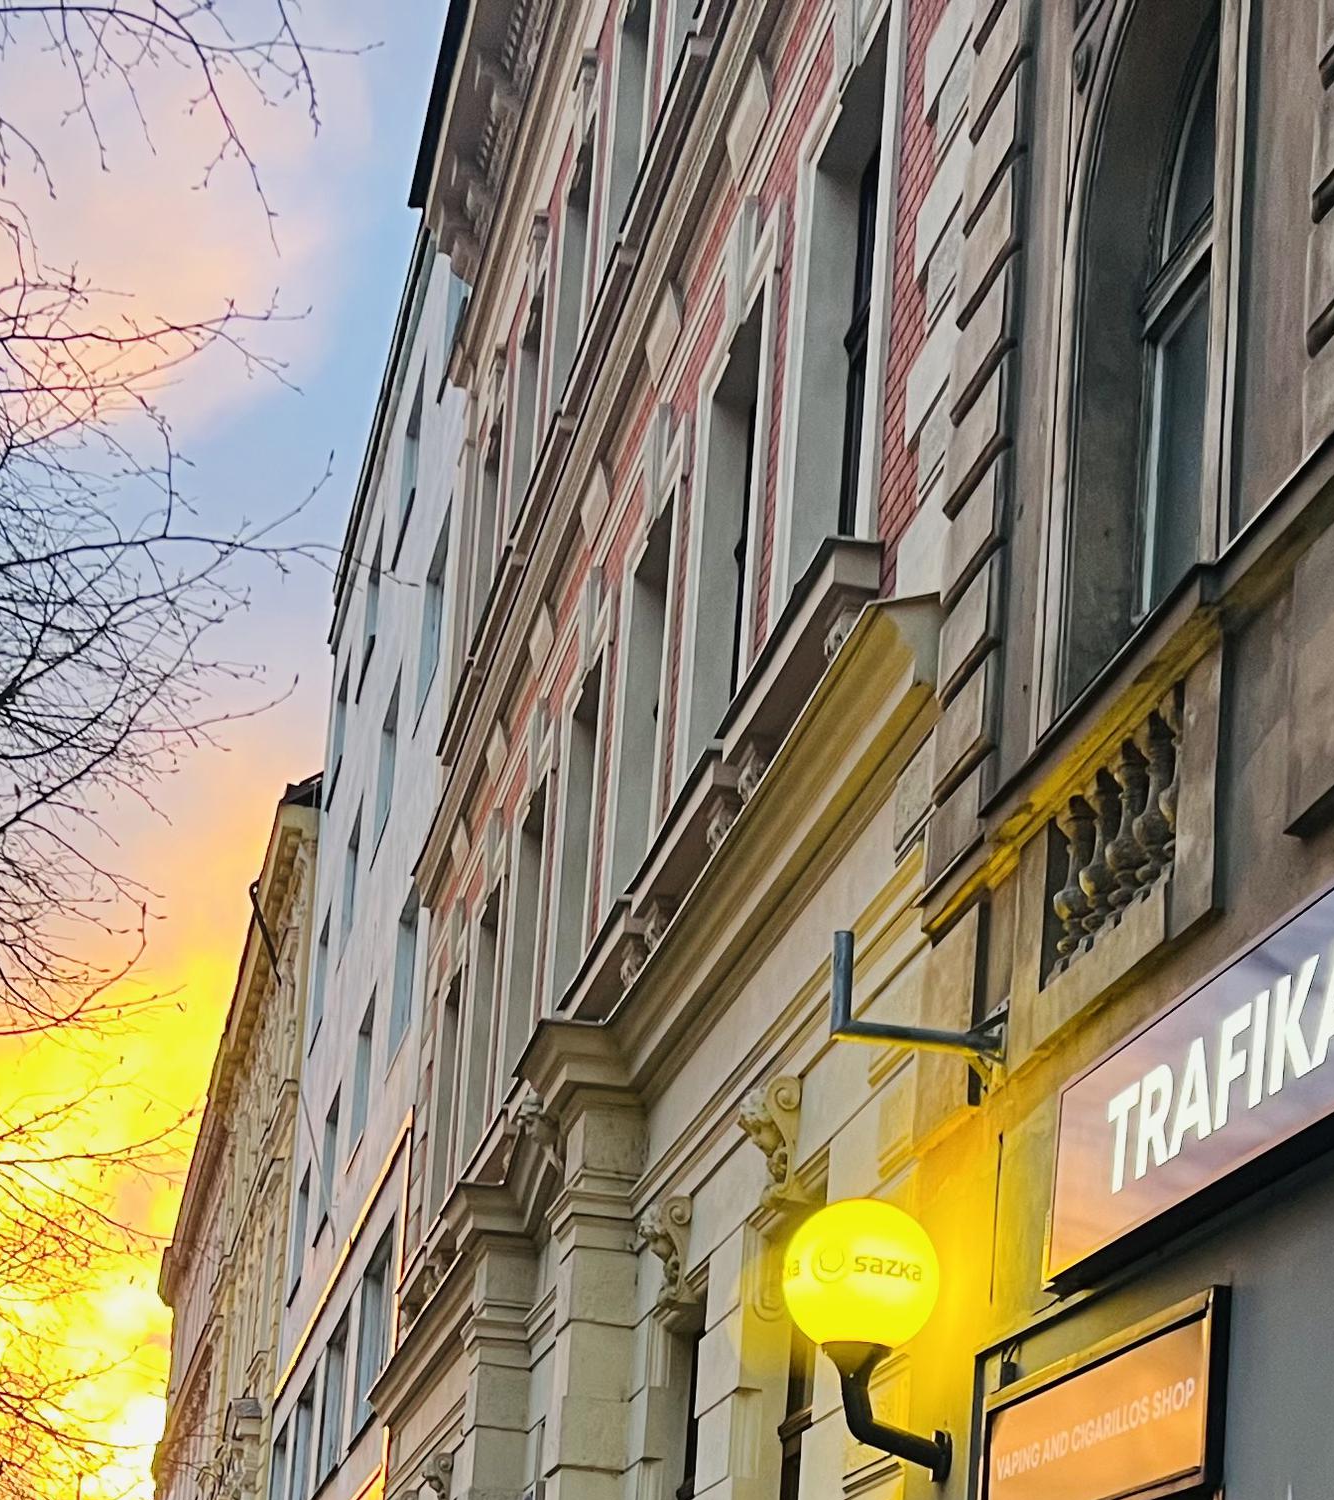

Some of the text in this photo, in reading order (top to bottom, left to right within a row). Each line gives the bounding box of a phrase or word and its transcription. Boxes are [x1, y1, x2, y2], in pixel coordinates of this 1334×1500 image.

[853, 1255, 923, 1282] sazka
[996, 1376, 1196, 1481] VAPING AND CIGARILLOS SHOP
